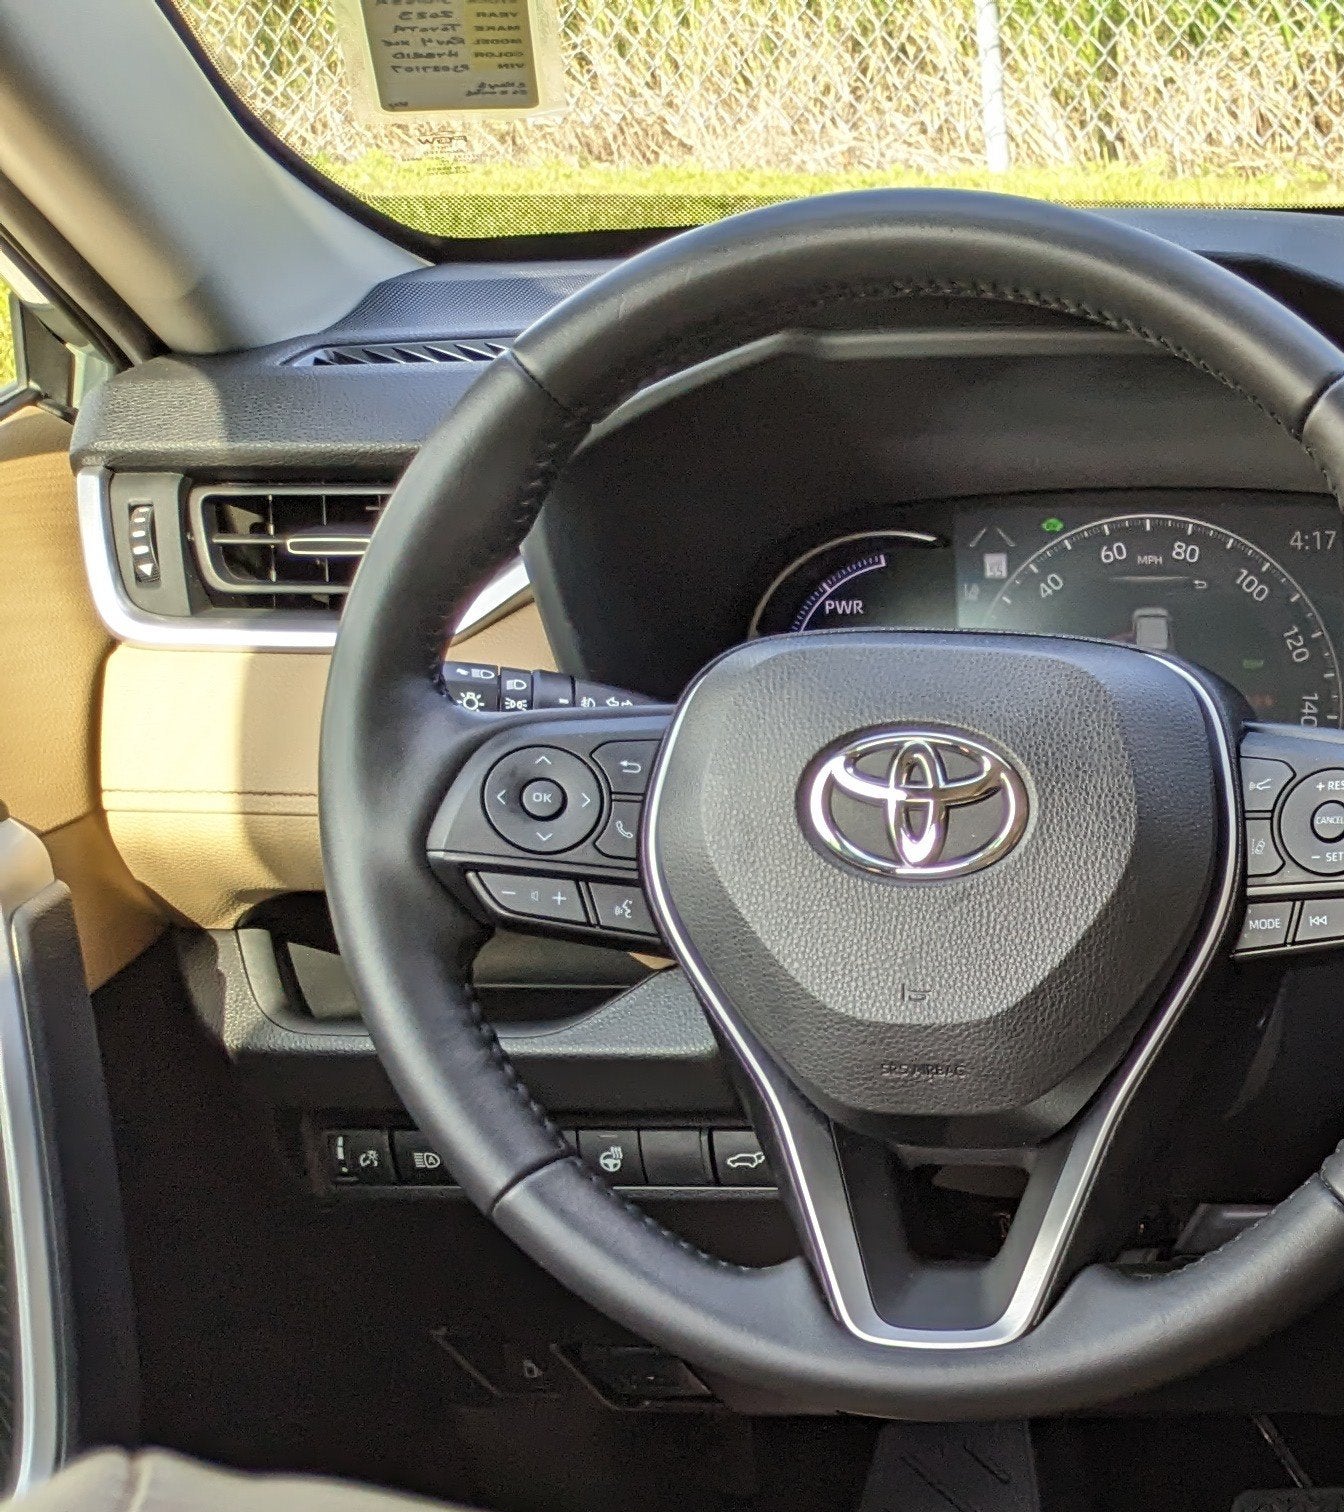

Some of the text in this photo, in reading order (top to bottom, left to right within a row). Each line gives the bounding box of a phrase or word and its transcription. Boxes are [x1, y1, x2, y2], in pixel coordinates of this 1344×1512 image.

[1290, 531, 1336, 550] 4:17
[1101, 542, 1127, 563] 60
[1137, 555, 1163, 565] MPH
[1172, 541, 1200, 563] 80
[1039, 574, 1063, 598] 40
[1236, 568, 1269, 602] 100
[825, 600, 864, 615] PWR
[1283, 625, 1310, 663] 120
[532, 792, 552, 803] OK
[1315, 816, 1344, 825] CANCEL
[1325, 852, 1344, 862] SET
[1249, 918, 1281, 930] MODE
